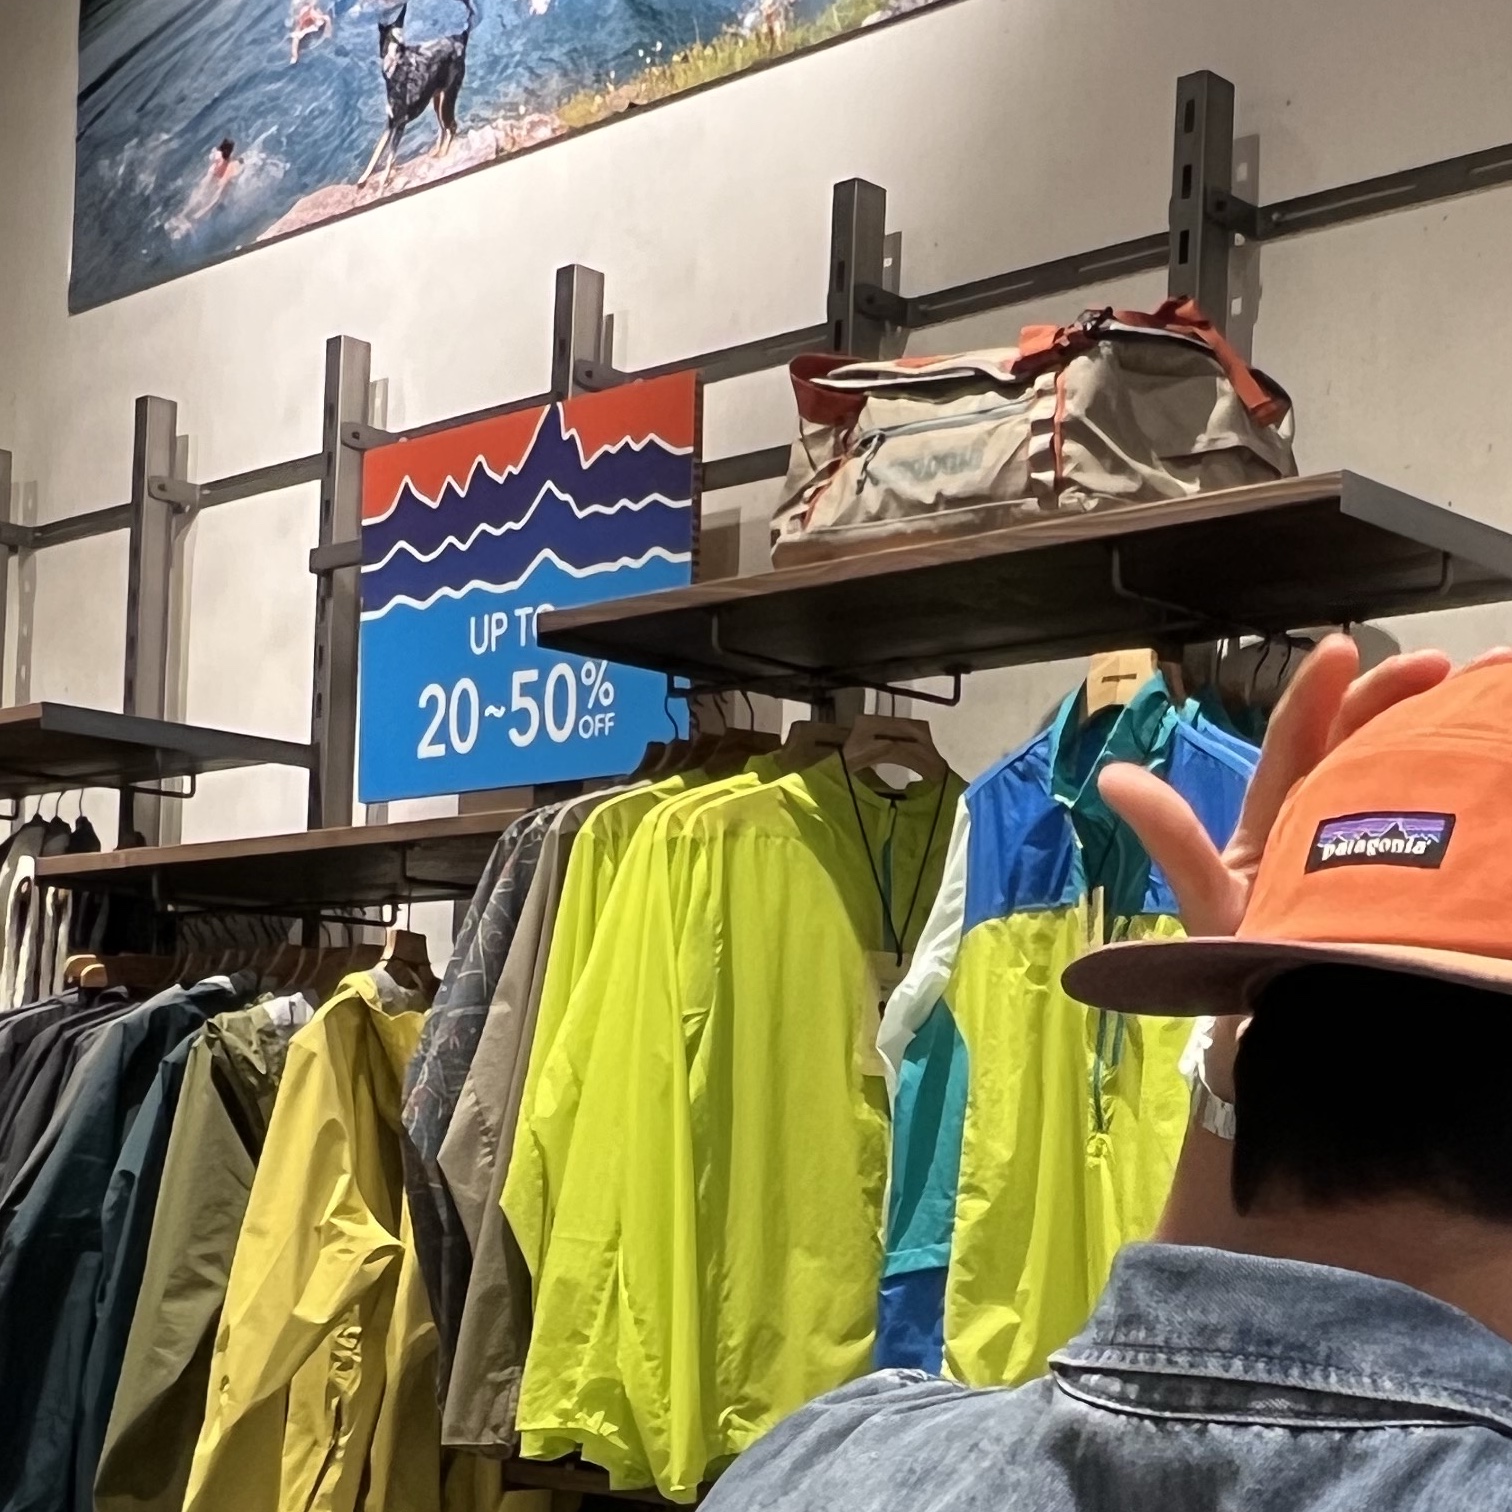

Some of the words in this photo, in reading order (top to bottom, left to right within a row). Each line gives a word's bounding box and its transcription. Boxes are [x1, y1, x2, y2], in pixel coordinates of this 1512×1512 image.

[469, 611, 508, 655] UP
[578, 712, 616, 739] OFF
[1321, 838, 1428, 861] patagonia
